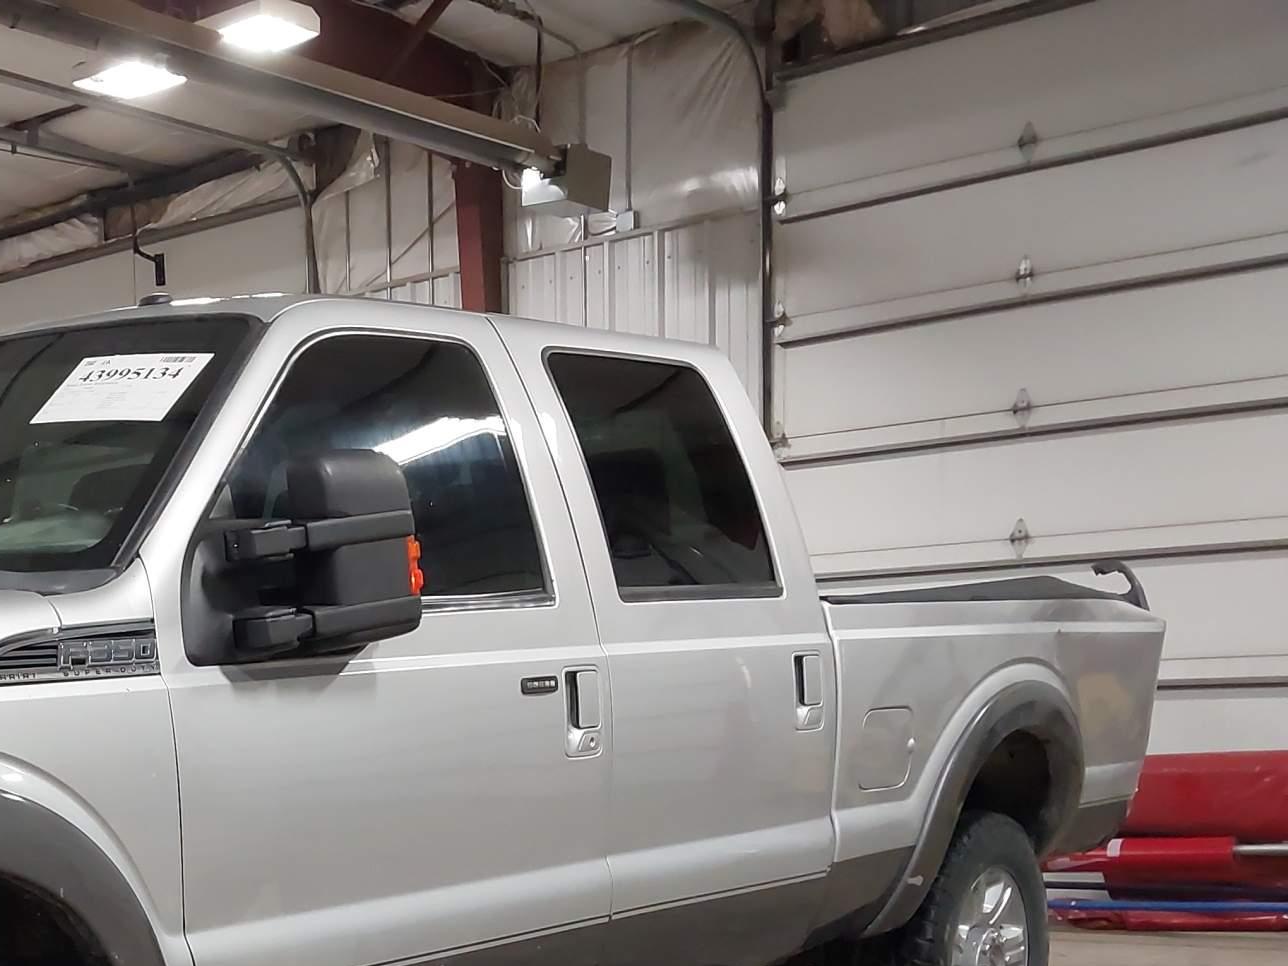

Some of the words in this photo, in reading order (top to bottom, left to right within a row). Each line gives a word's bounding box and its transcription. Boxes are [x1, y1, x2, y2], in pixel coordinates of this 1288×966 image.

[78, 366, 185, 382] 43995134
[63, 666, 112, 677] SUPER
[119, 662, 158, 674] DUTY
